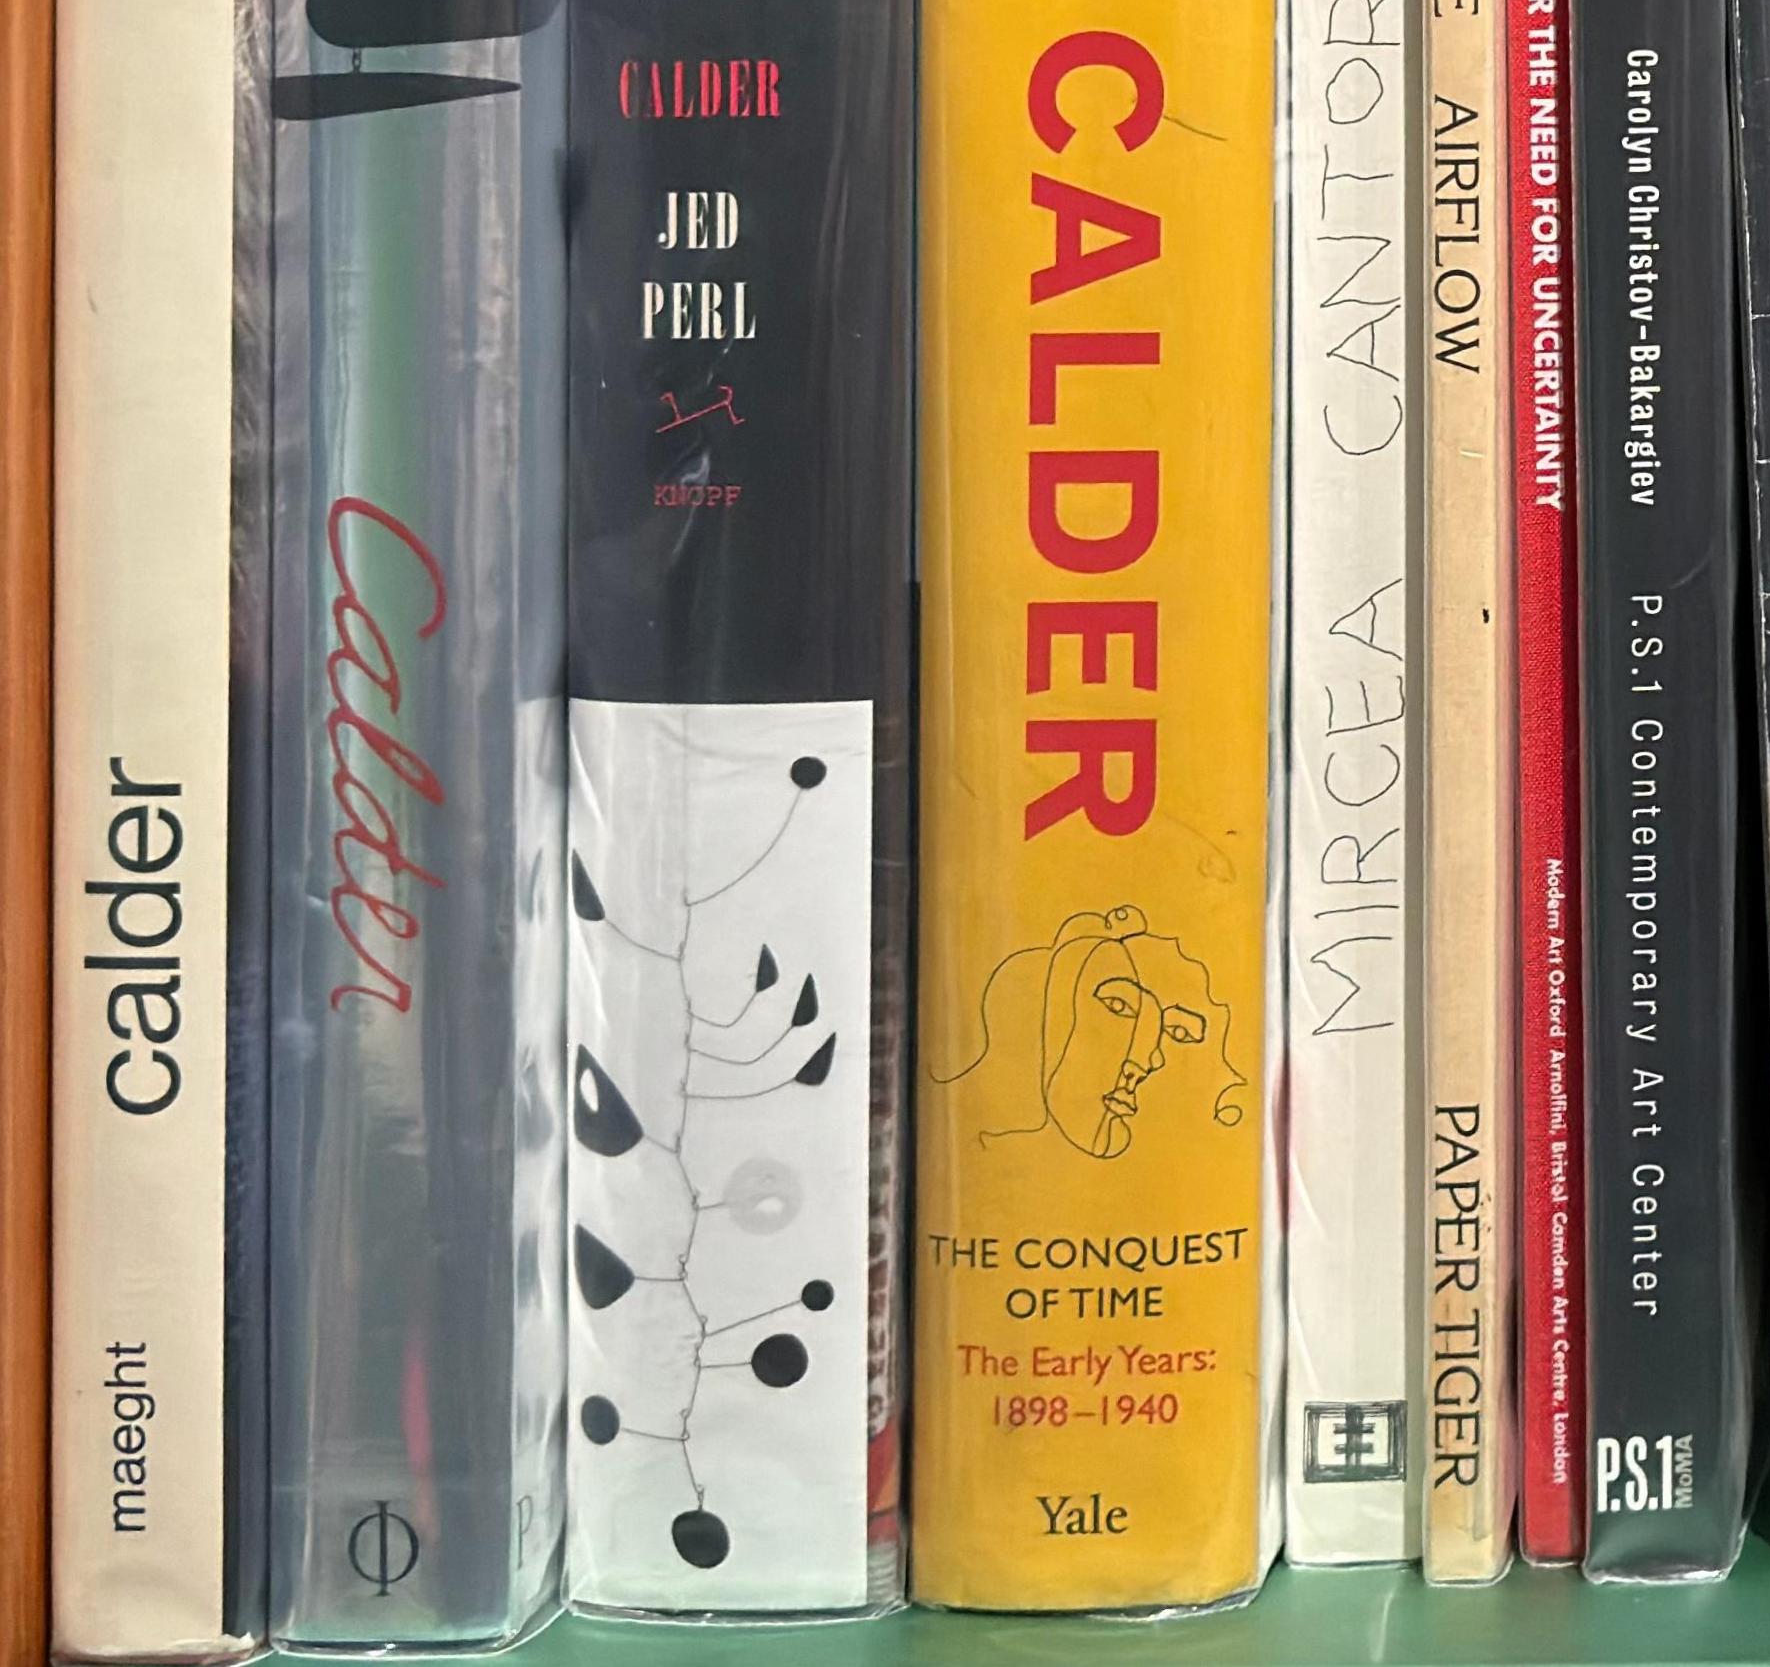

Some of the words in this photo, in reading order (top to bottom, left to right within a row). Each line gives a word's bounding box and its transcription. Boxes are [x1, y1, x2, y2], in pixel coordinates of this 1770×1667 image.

[619, 60, 781, 118] CALDER
[1528, 25, 1558, 86] THE
[1530, 98, 1558, 186] NEED
[1622, 48, 1659, 174] Carolyn
[658, 192, 739, 249] JED
[1434, 95, 1481, 374] AIRFLOW
[1531, 197, 1560, 266] FOR
[642, 282, 756, 339] PERL
[1625, 185, 1662, 506] Christov-Bakargiev
[1532, 276, 1565, 512] UNCERTAINTY
[1024, 30, 1166, 842] CALDER
[654, 486, 741, 507] KNOPF
[1630, 593, 1663, 695] P.S.1
[1310, 578, 1404, 1035] MIRCEA
[1547, 858, 1565, 929] Modern
[1625, 719, 1663, 1042] Contemporary
[84, 756, 183, 1115] calder
[1548, 938, 1566, 965] Art
[1548, 970, 1566, 1038] Oxford
[1632, 1068, 1664, 1139] Art
[1434, 1103, 1481, 1295] PAPER
[1551, 1141, 1568, 1204] Bristol
[928, 1235, 999, 1268] THE
[1014, 1228, 1249, 1272] CONQUEST
[1551, 1213, 1568, 1289] Camden
[1632, 1164, 1664, 1317] Center
[1005, 1288, 1060, 1319] OF
[1070, 1287, 1164, 1318] TIME
[1552, 1294, 1569, 1334] Arts
[958, 1345, 1018, 1376] The
[1032, 1344, 1112, 1386] Early
[1118, 1344, 1216, 1374] Years:
[1433, 1309, 1481, 1490] TIGER
[107, 1340, 148, 1533] maeght
[1552, 1412, 1570, 1485] London
[1597, 1435, 1673, 1512] P.S.1
[1674, 1434, 1694, 1509] MoMA
[1036, 1493, 1128, 1535] Yale
